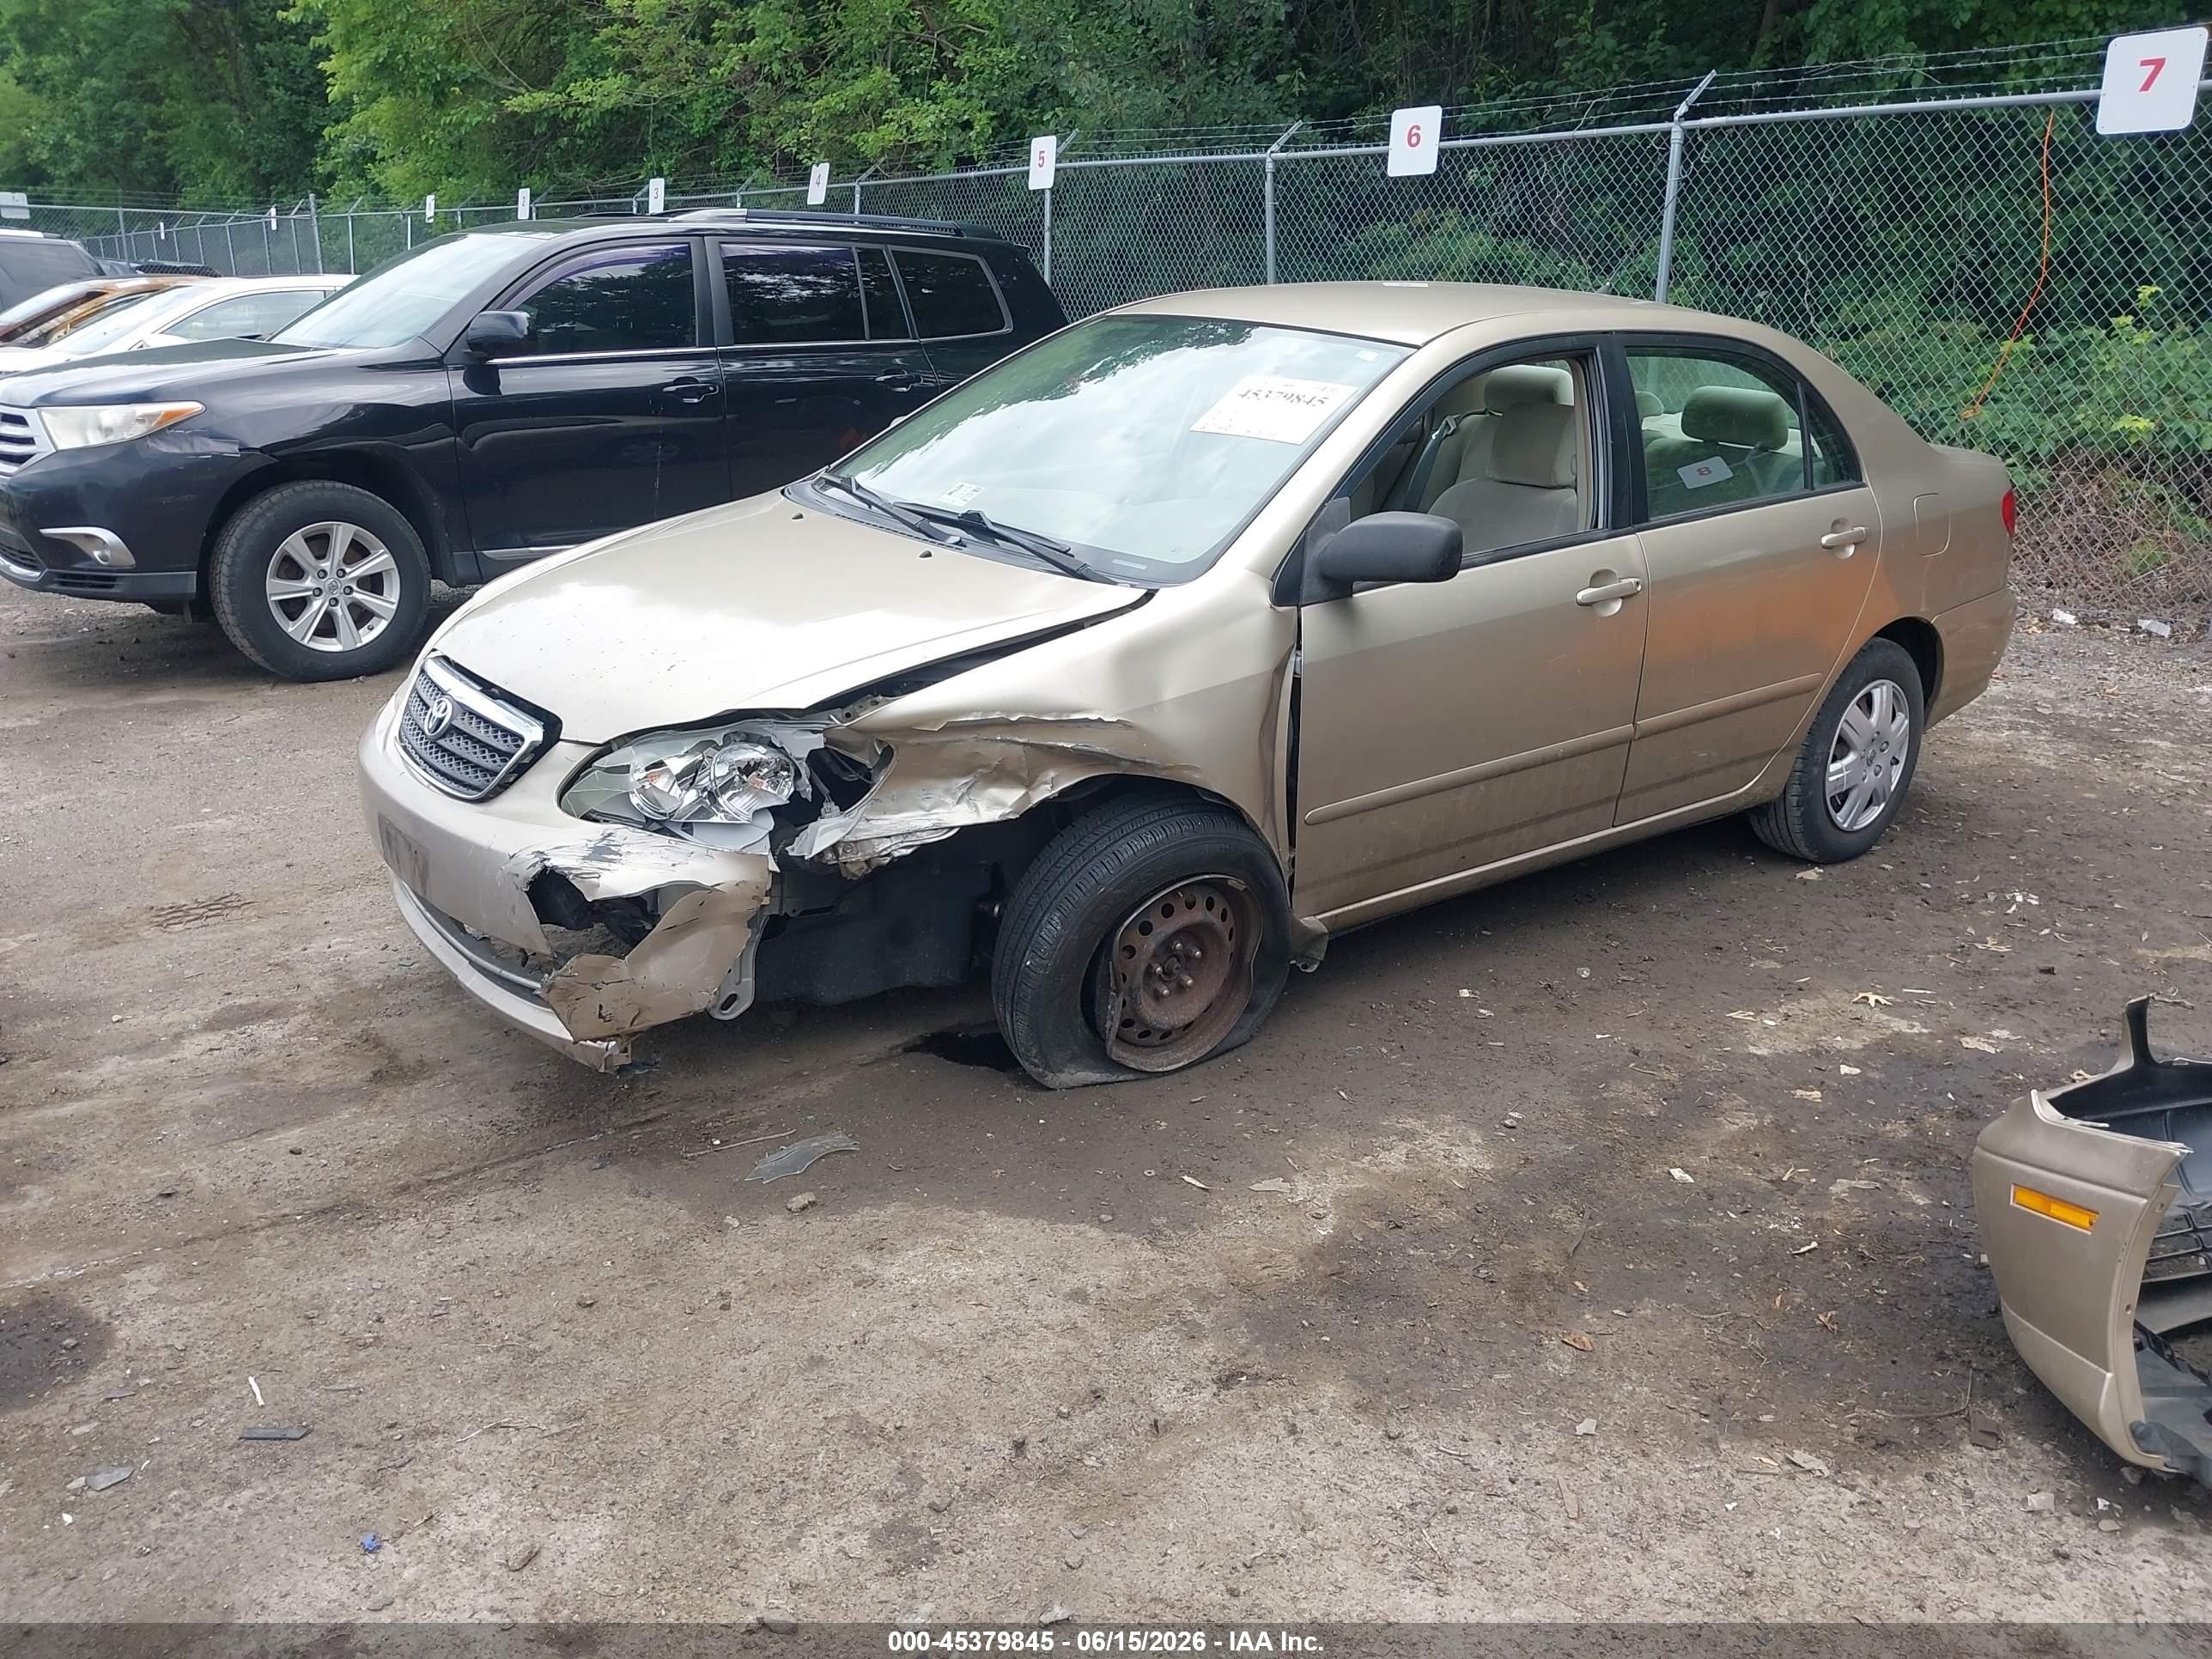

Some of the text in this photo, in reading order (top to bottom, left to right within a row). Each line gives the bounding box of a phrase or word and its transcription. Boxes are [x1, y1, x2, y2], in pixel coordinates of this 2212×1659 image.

[2138, 57, 2166, 93] 7
[1407, 124, 1422, 148] 6
[1038, 150, 1045, 168] 5
[815, 173, 822, 187] 4
[653, 187, 659, 199] 3
[521, 196, 526, 207] 2
